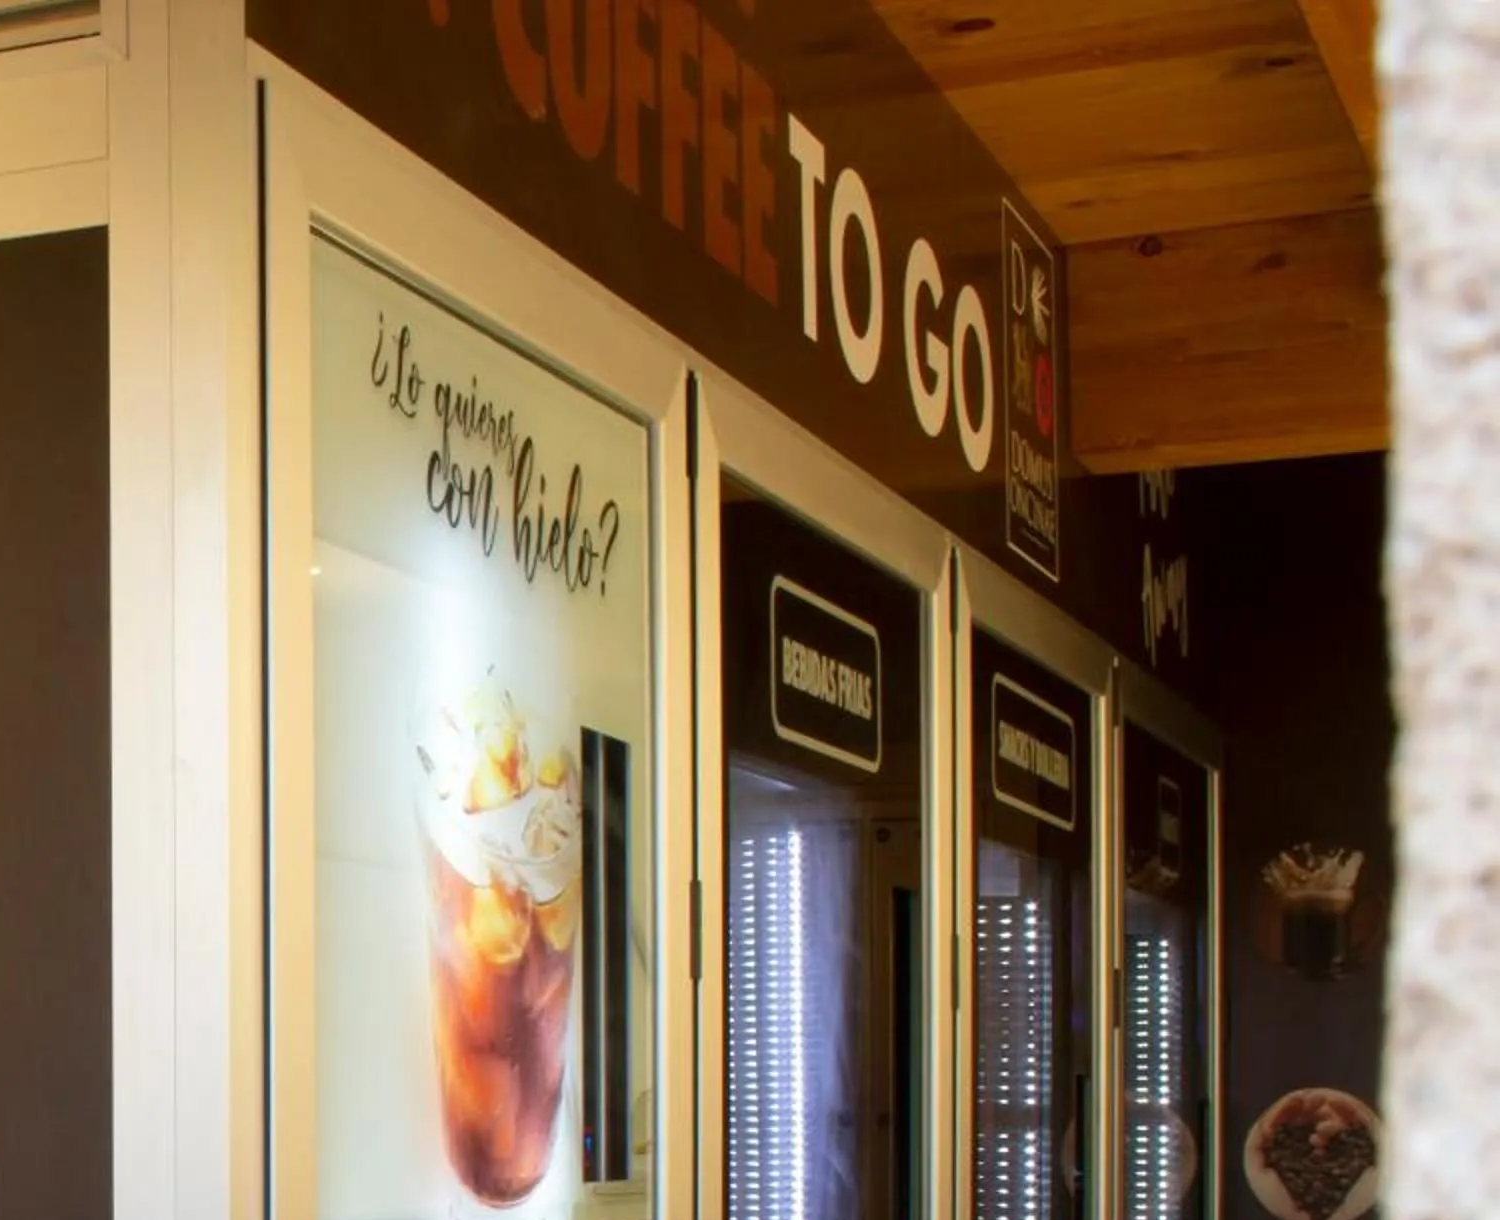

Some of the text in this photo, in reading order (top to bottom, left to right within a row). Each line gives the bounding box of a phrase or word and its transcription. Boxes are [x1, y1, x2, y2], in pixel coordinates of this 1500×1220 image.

[788, 112, 884, 385] TO
[904, 236, 994, 474] GO
[371, 310, 517, 481] ¿Lo quieres
[427, 436, 620, 598] con hielo?
